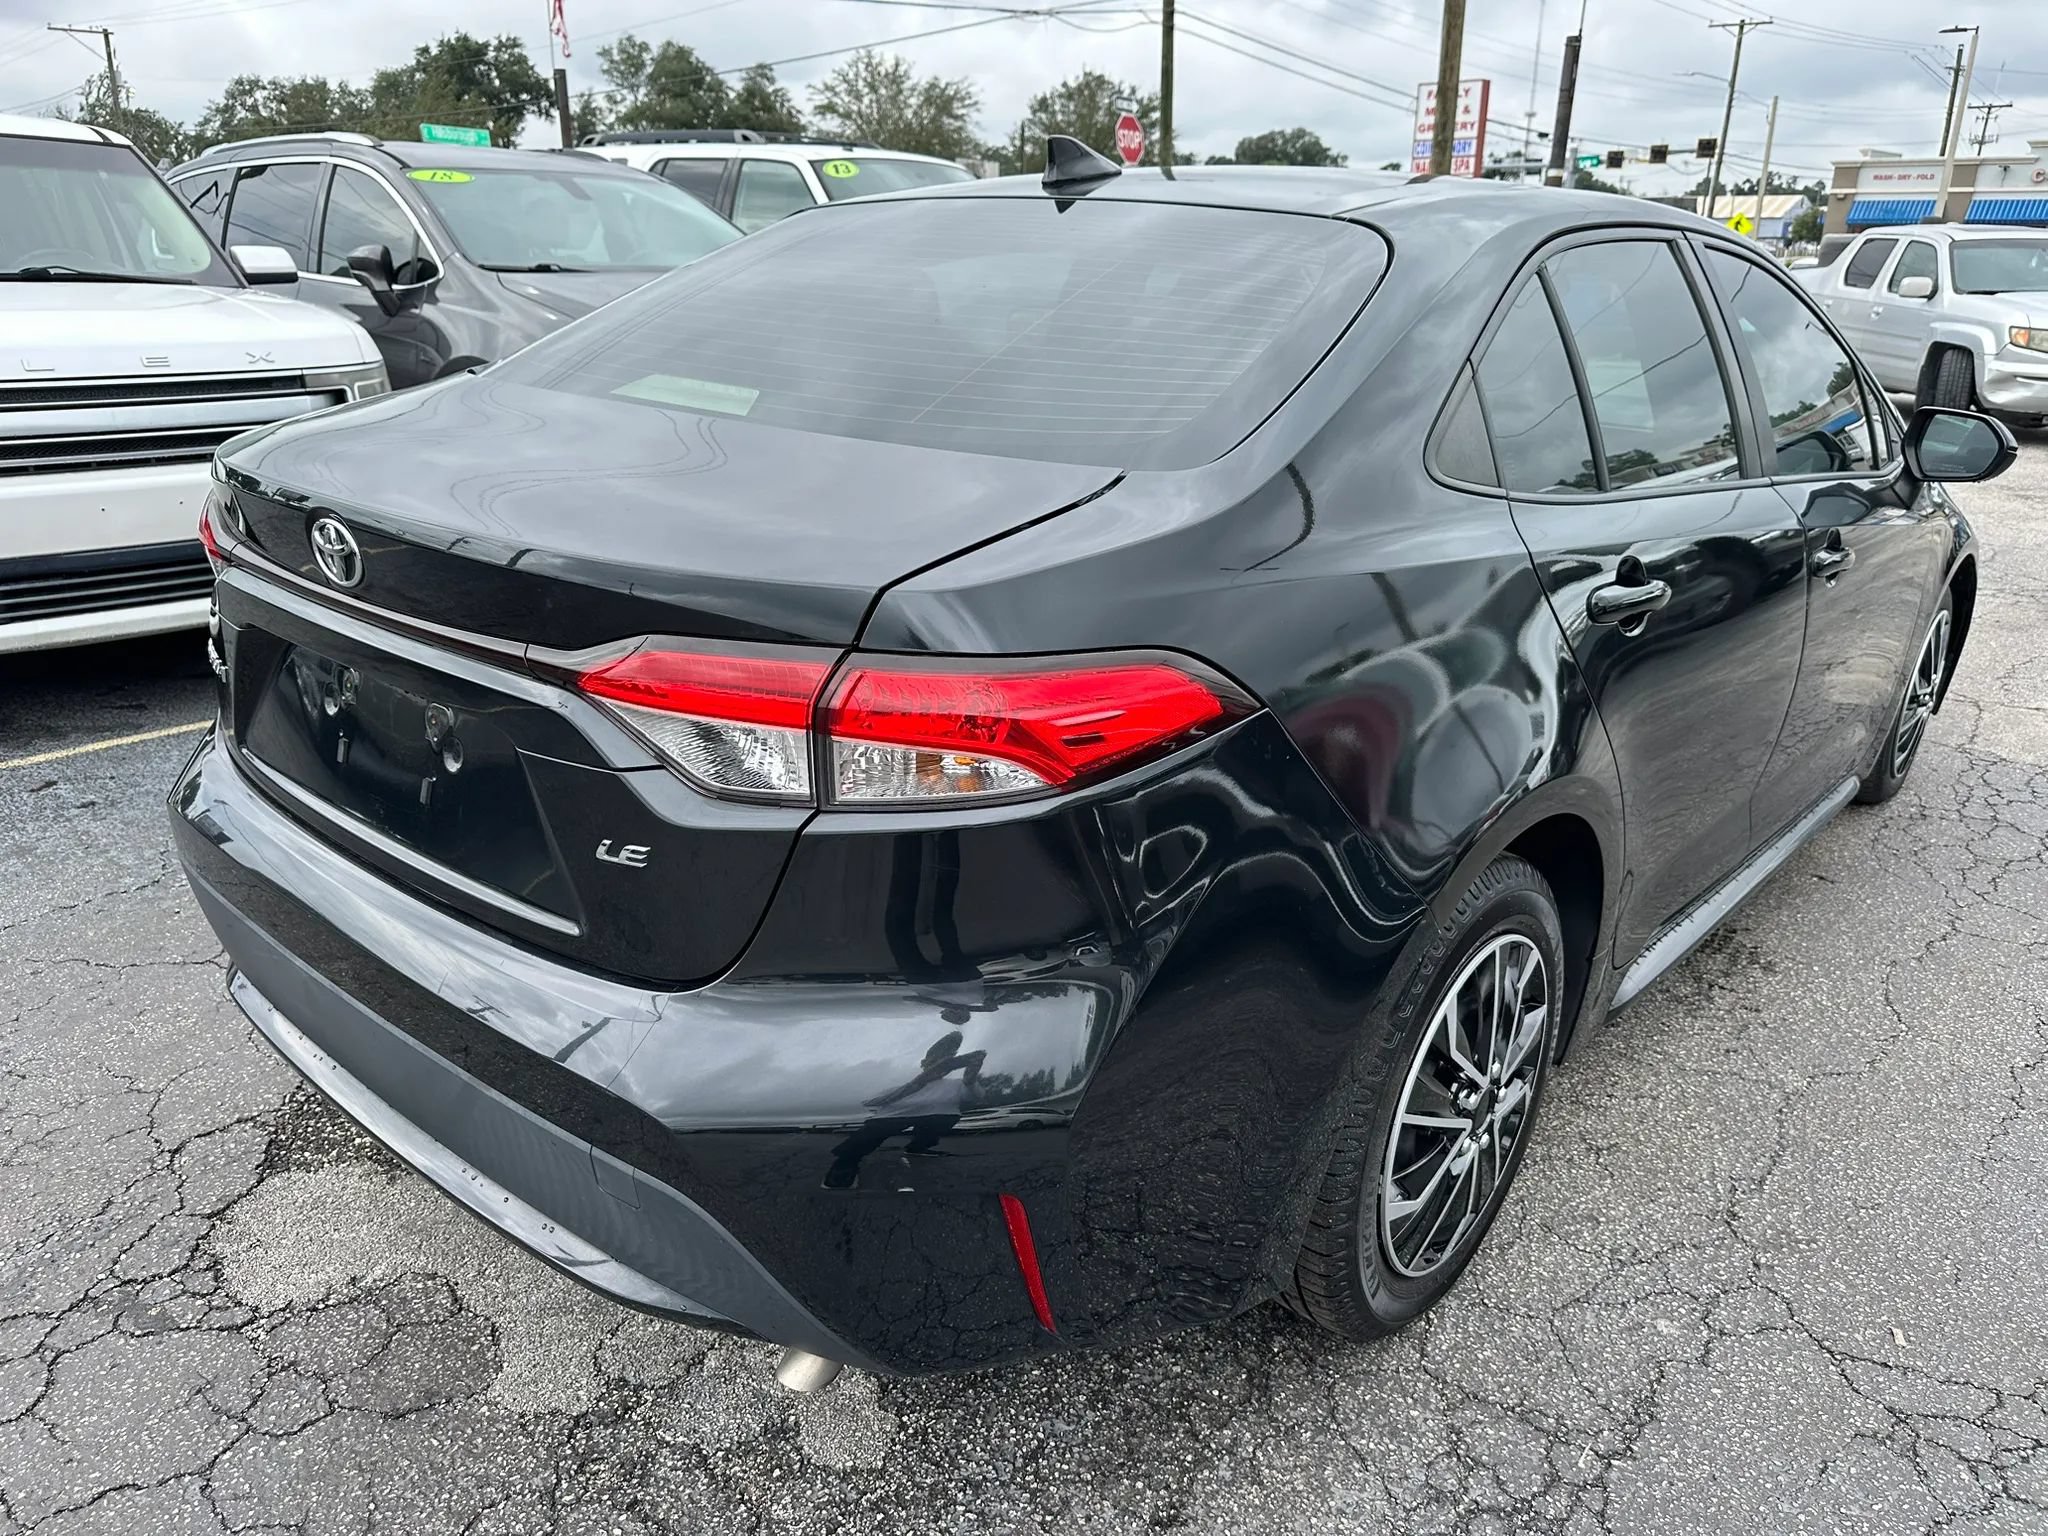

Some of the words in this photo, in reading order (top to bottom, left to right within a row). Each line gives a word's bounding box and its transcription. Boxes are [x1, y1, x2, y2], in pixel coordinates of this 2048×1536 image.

[1118, 129, 1140, 149] STOP
[832, 163, 852, 175] 13
[595, 839, 652, 868] LE
